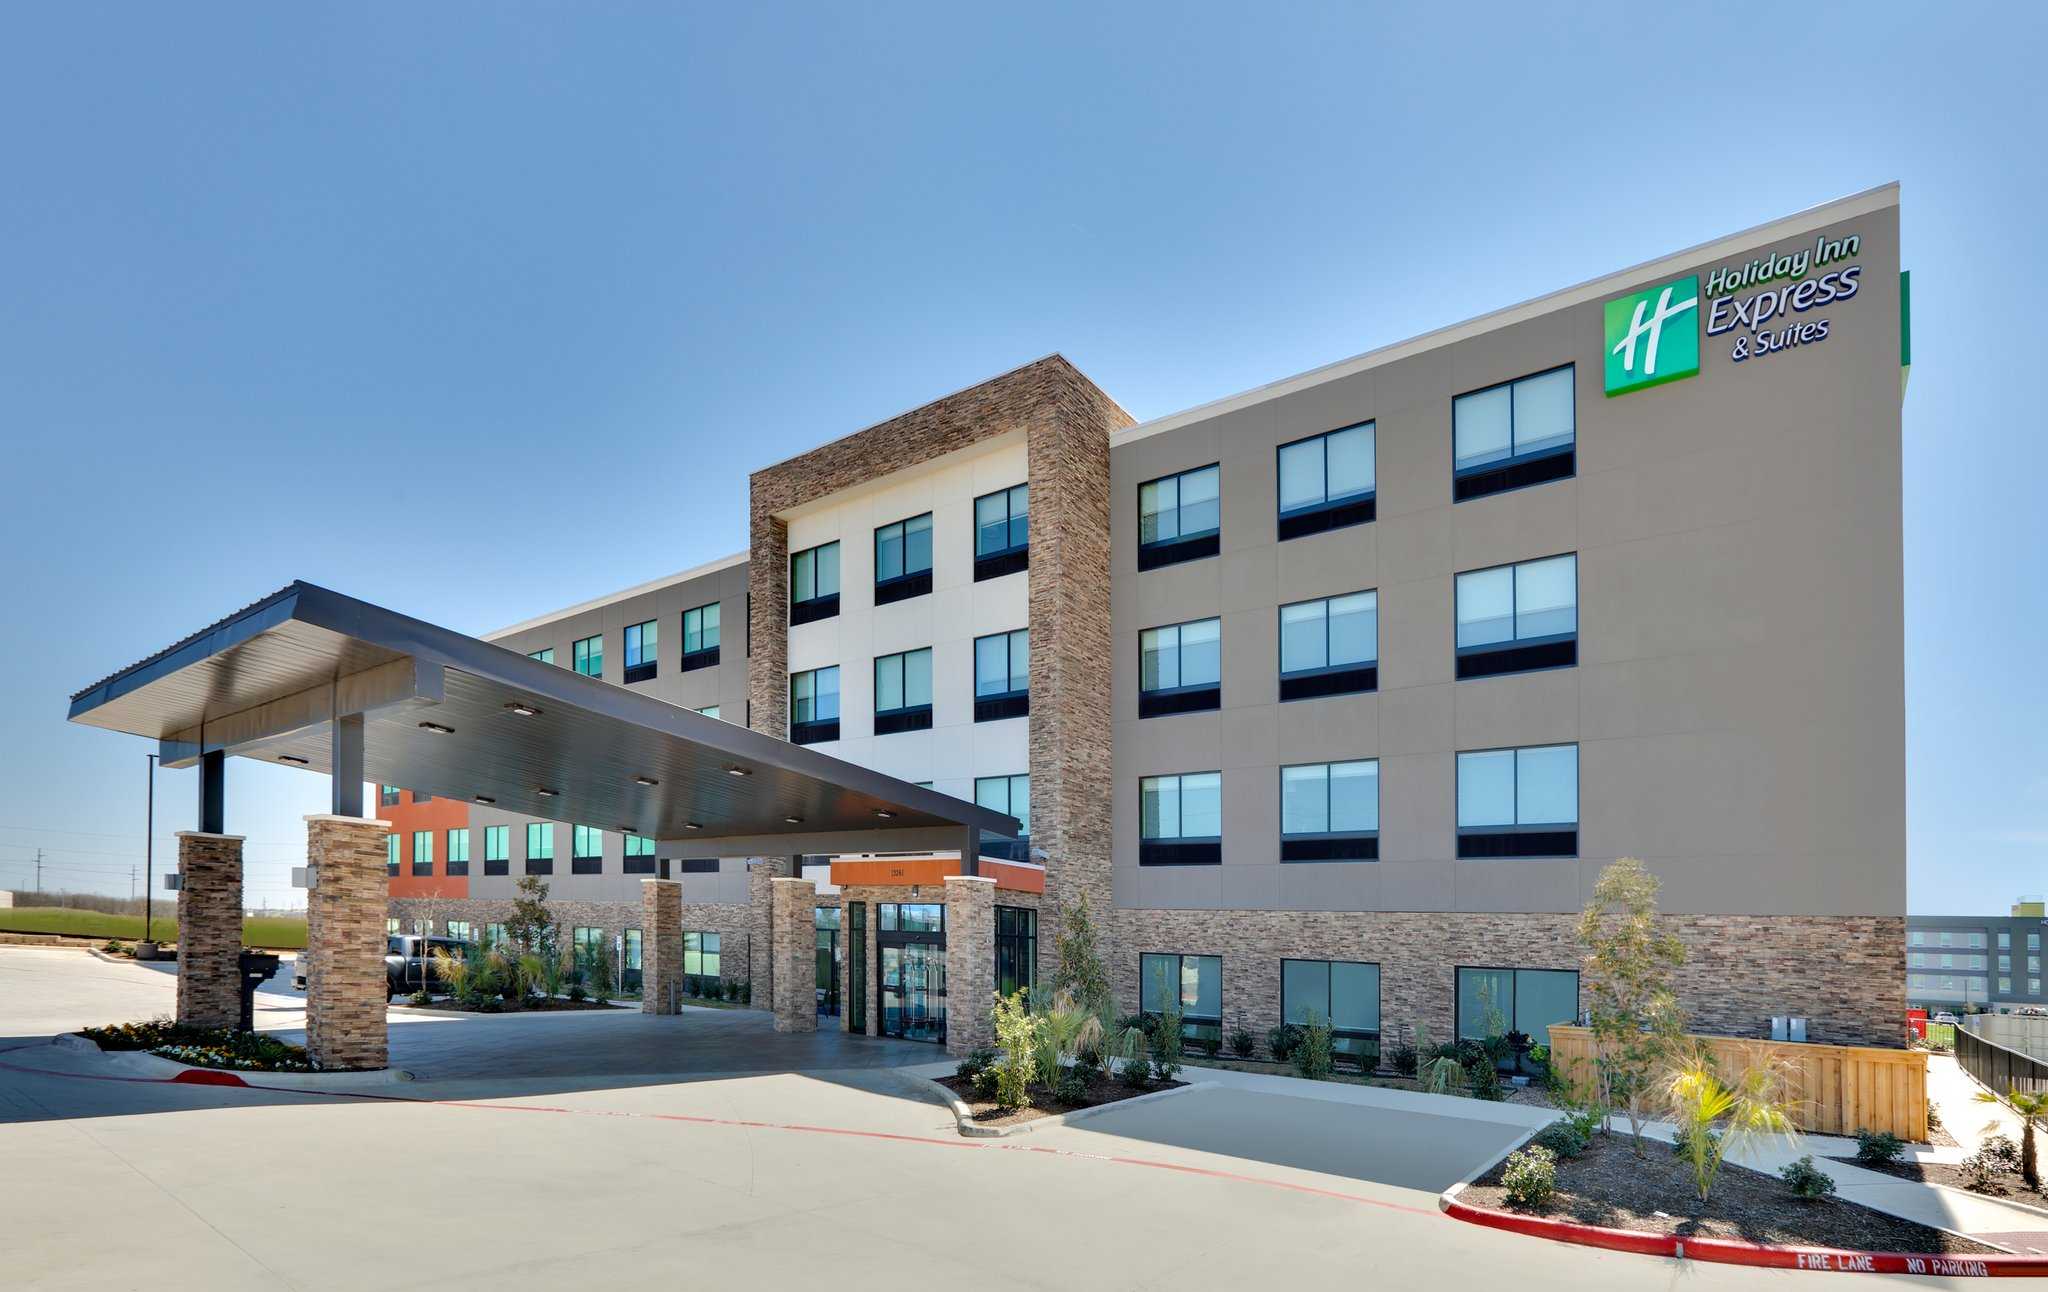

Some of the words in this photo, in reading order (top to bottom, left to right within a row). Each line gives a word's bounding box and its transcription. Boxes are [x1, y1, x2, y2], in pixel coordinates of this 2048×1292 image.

[1706, 251, 1809, 296] Holiday
[1815, 234, 1861, 265] Inn
[1706, 266, 1861, 336] Express
[1732, 336, 1750, 361] &
[1754, 319, 1830, 357] Suites
[1797, 1254, 1832, 1270] FIRE
[1838, 1255, 1875, 1272] LANE
[1906, 1258, 1927, 1275] NO
[1932, 1258, 1989, 1277] PARKING
